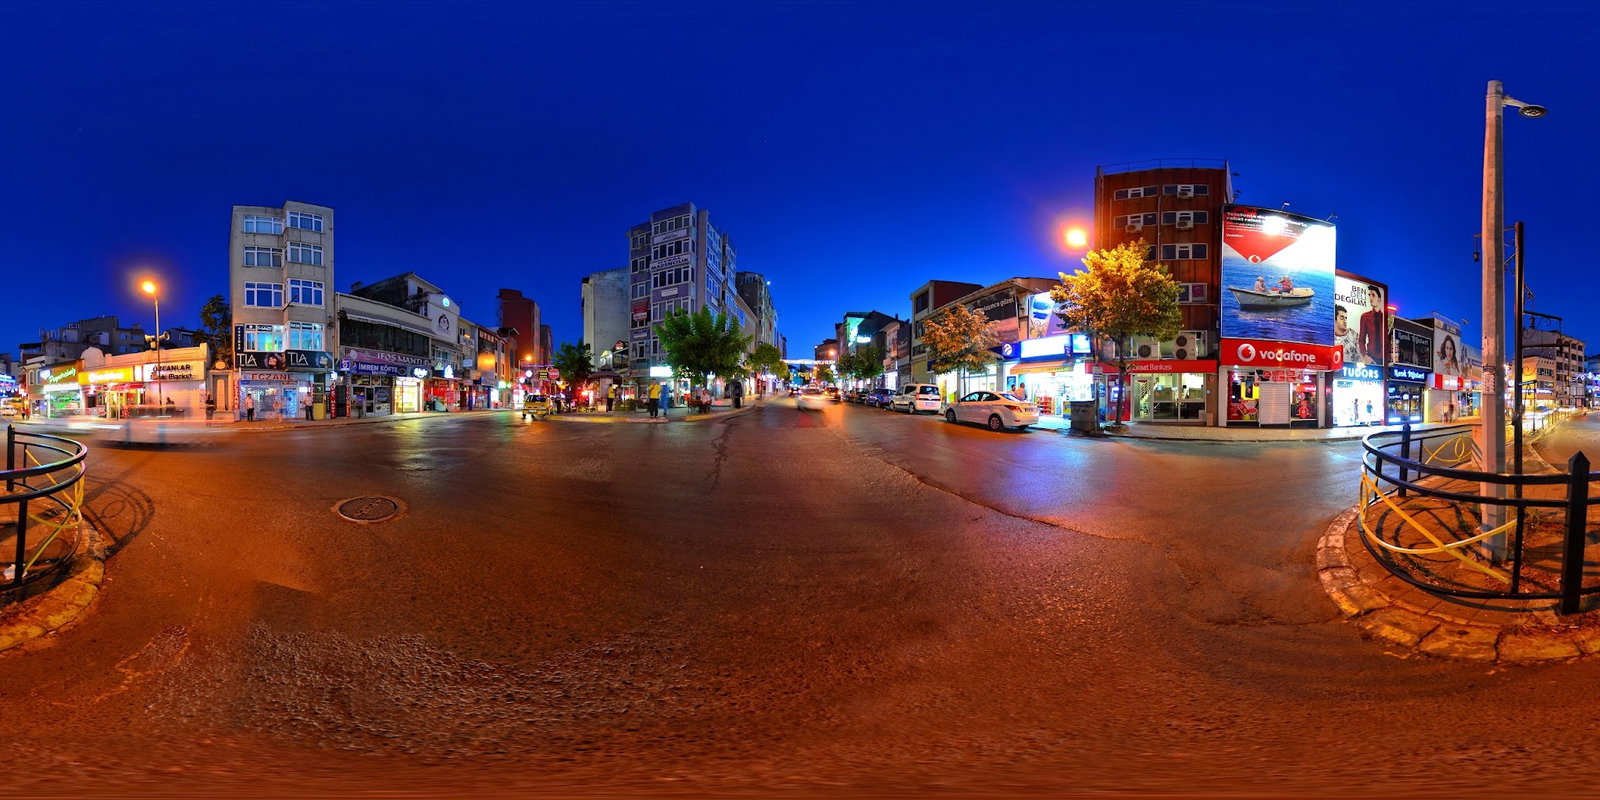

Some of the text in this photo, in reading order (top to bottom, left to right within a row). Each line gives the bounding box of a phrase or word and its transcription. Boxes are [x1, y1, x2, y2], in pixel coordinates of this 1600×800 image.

[1352, 286, 1366, 294] BEN
[1260, 350, 1316, 362] vodafone
[1342, 366, 1378, 378] TUDORS
